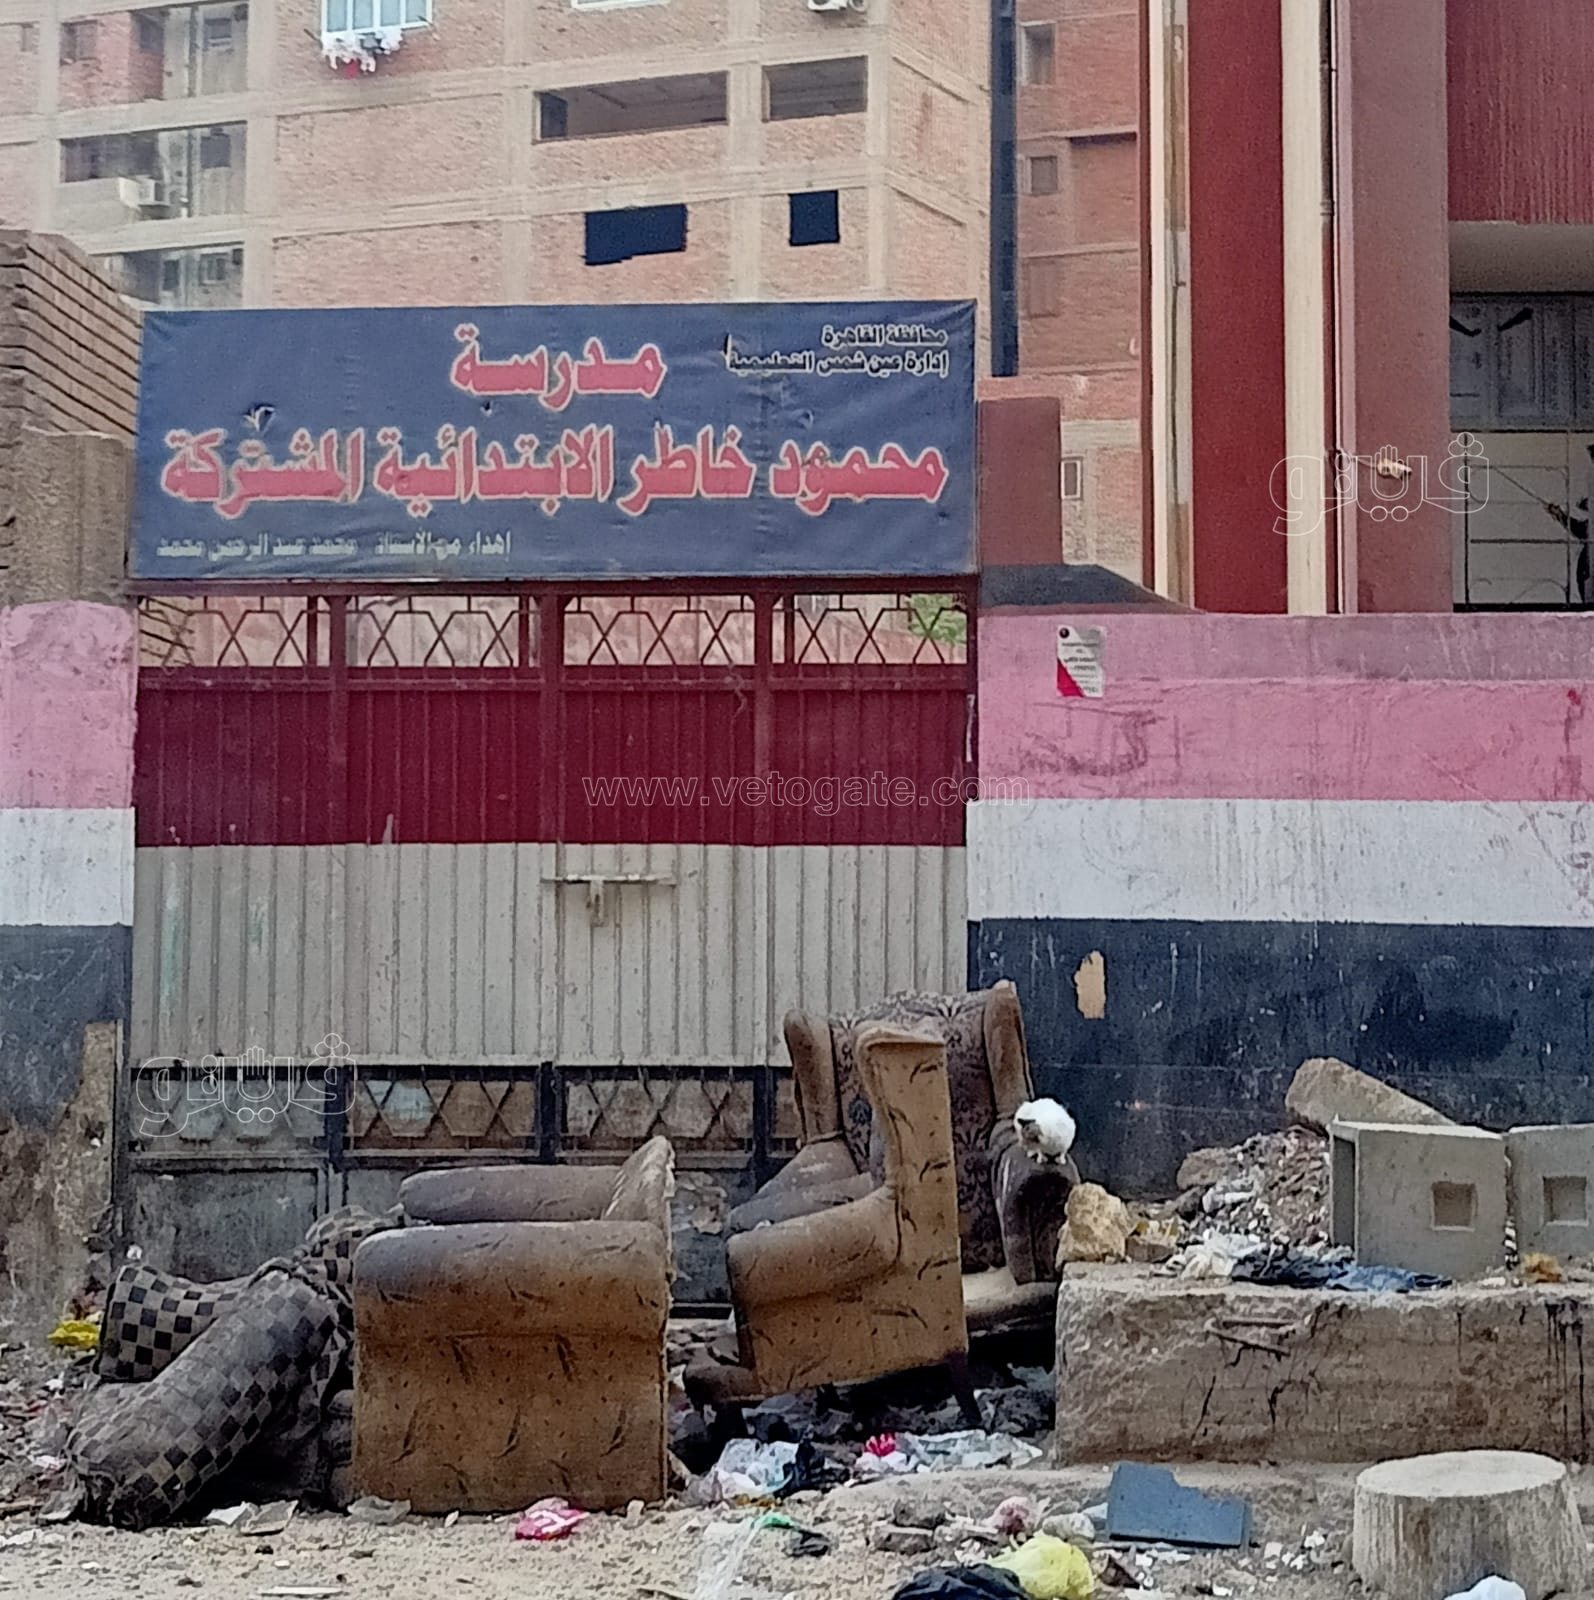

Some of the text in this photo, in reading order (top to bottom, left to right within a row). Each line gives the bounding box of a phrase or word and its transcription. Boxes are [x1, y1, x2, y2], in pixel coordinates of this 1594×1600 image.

[822, 323, 949, 348] محافظة القاهرة
[450, 323, 667, 411] مدرسة
[816, 350, 868, 376] شمس
[905, 349, 949, 378] إدارة
[161, 423, 950, 518] محمود خاطر الابتدائية المشتركة
[156, 537, 206, 557] محمد
[309, 537, 358, 556] محمد
